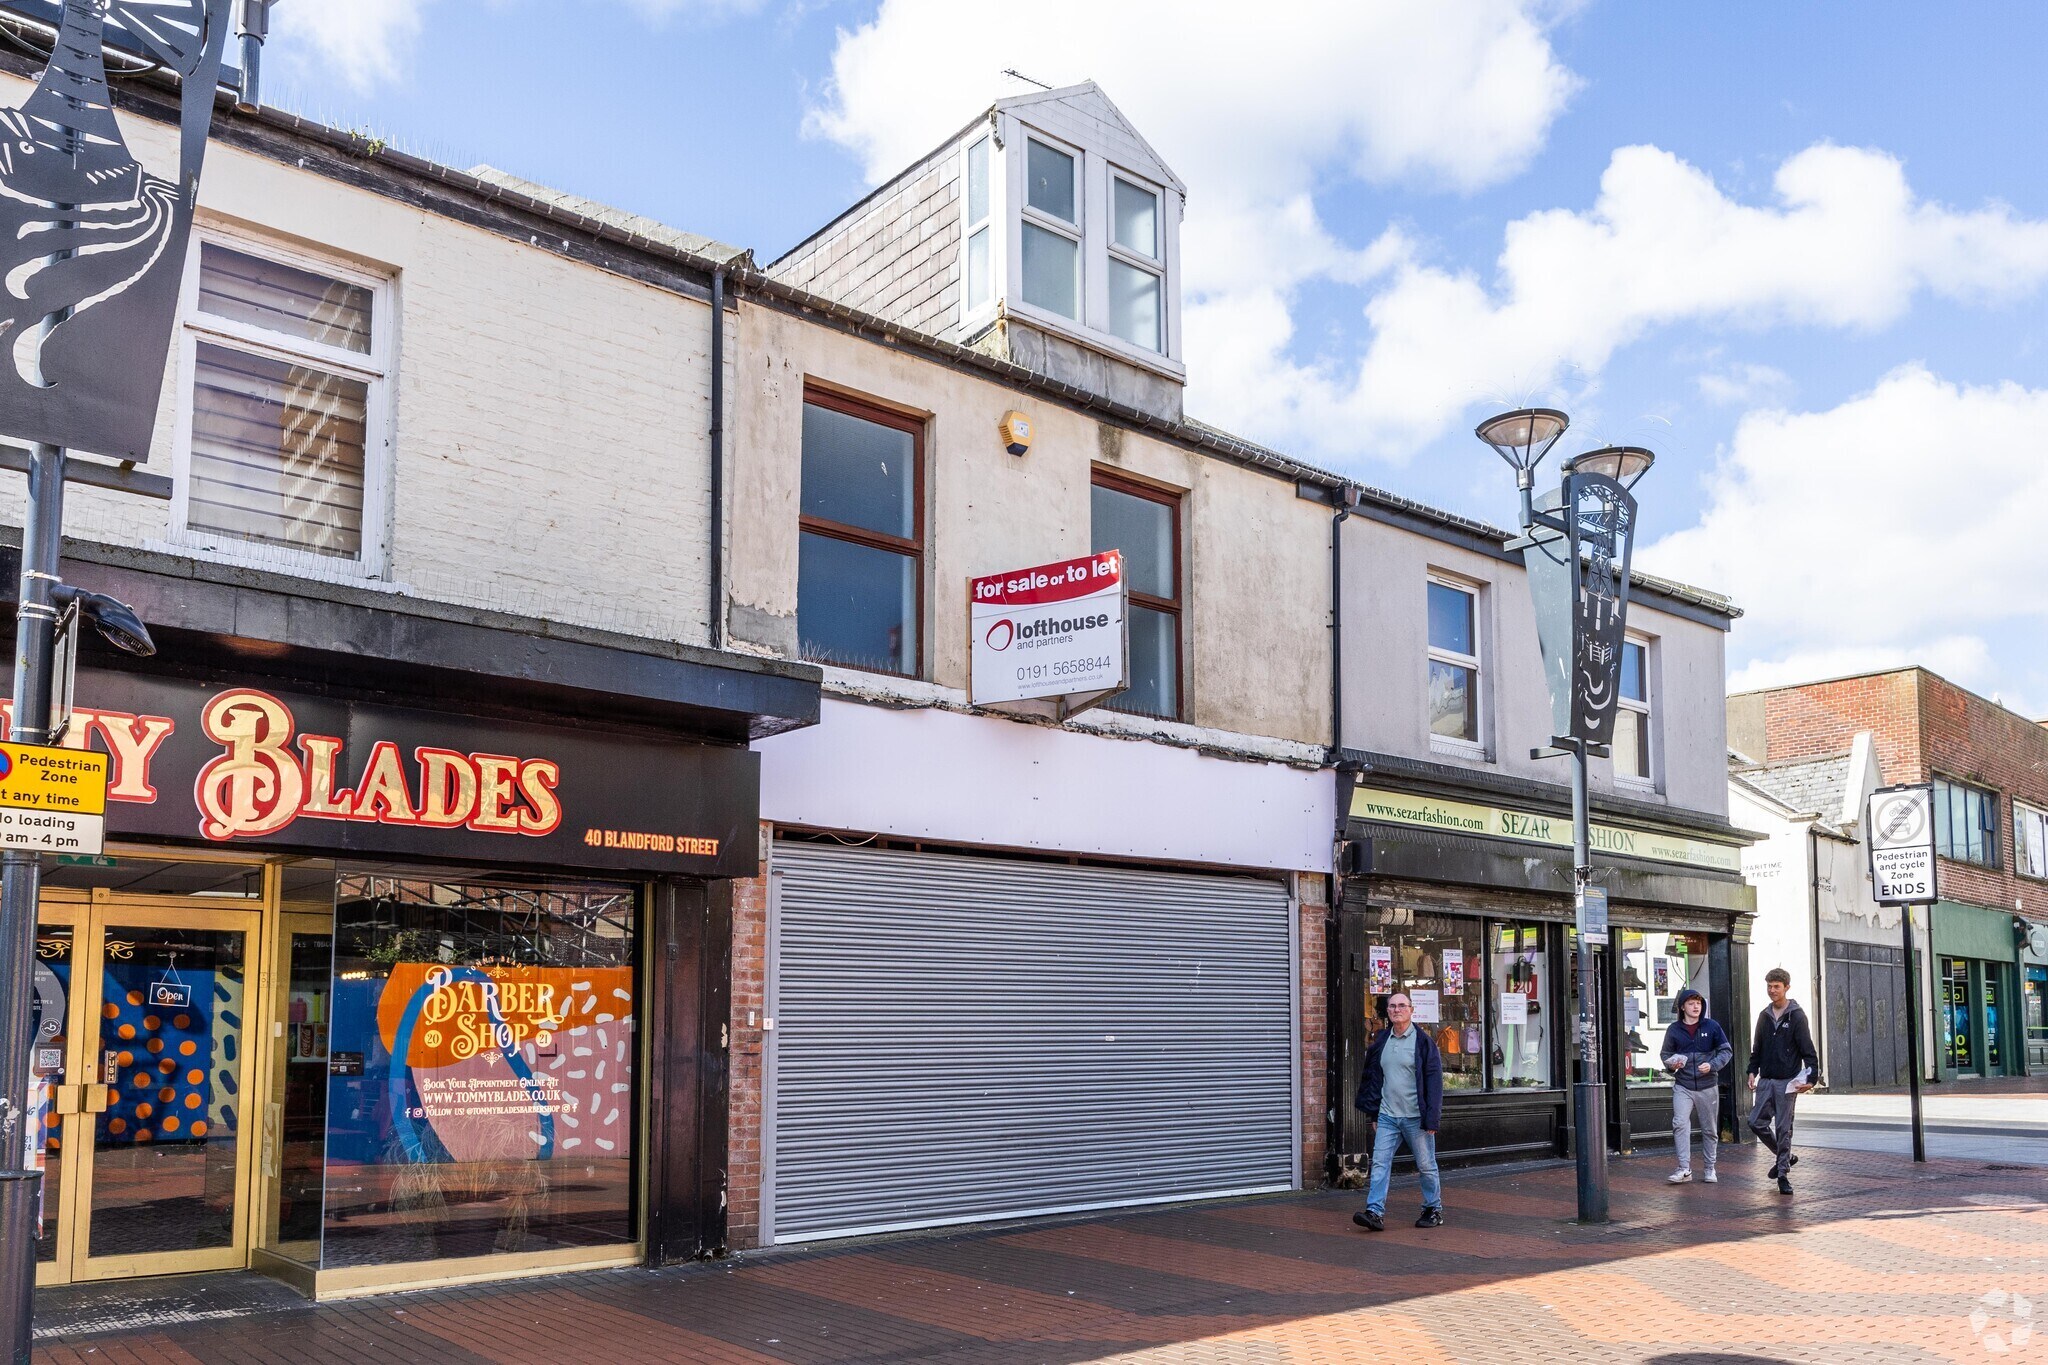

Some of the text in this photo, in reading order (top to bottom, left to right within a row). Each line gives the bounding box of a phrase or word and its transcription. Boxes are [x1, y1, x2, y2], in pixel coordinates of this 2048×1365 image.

[976, 556, 1118, 599] for sale or to let
[1016, 613, 1109, 640] lofthouse
[1017, 634, 1073, 650] and partners
[1016, 655, 1111, 681] 0191 5658844
[1017, 673, 1104, 690] www.lofthouseandpartners.co.uk
[20, 754, 101, 772] Pedestrian
[194, 687, 562, 842] BLADES
[40, 770, 78, 784] Zone
[13, 792, 41, 804] any
[46, 791, 80, 806] time
[0, 813, 75, 830] o loading
[6, 833, 29, 843] am
[41, 833, 52, 844] 4
[56, 836, 79, 848] pm
[584, 828, 719, 856] 40 BLANDFORD STREET
[1366, 803, 1732, 867] www.sezarfashion.com SEZAR SHION www.sezarfashion.com
[1876, 851, 1928, 861] Pedestrian
[1747, 870, 1780, 878] TREET
[1880, 860, 1925, 871] and cycle
[1881, 882, 1926, 896] ENDS
[465, 955, 531, 977] TOMMY BLADES
[157, 986, 184, 1003] Open
[1513, 980, 1533, 993] 20
[423, 965, 565, 1026] BARBER
[427, 1013, 548, 1060] 20 SHOP 21
[423, 1077, 559, 1091] BOOK YOUR APPOINTMENT ONLINE AT
[423, 1090, 561, 1104] WWW.TOMMYBLADES.CO.UK
[424, 1105, 452, 1119] FOLLOW
[454, 1107, 465, 1116] US!
